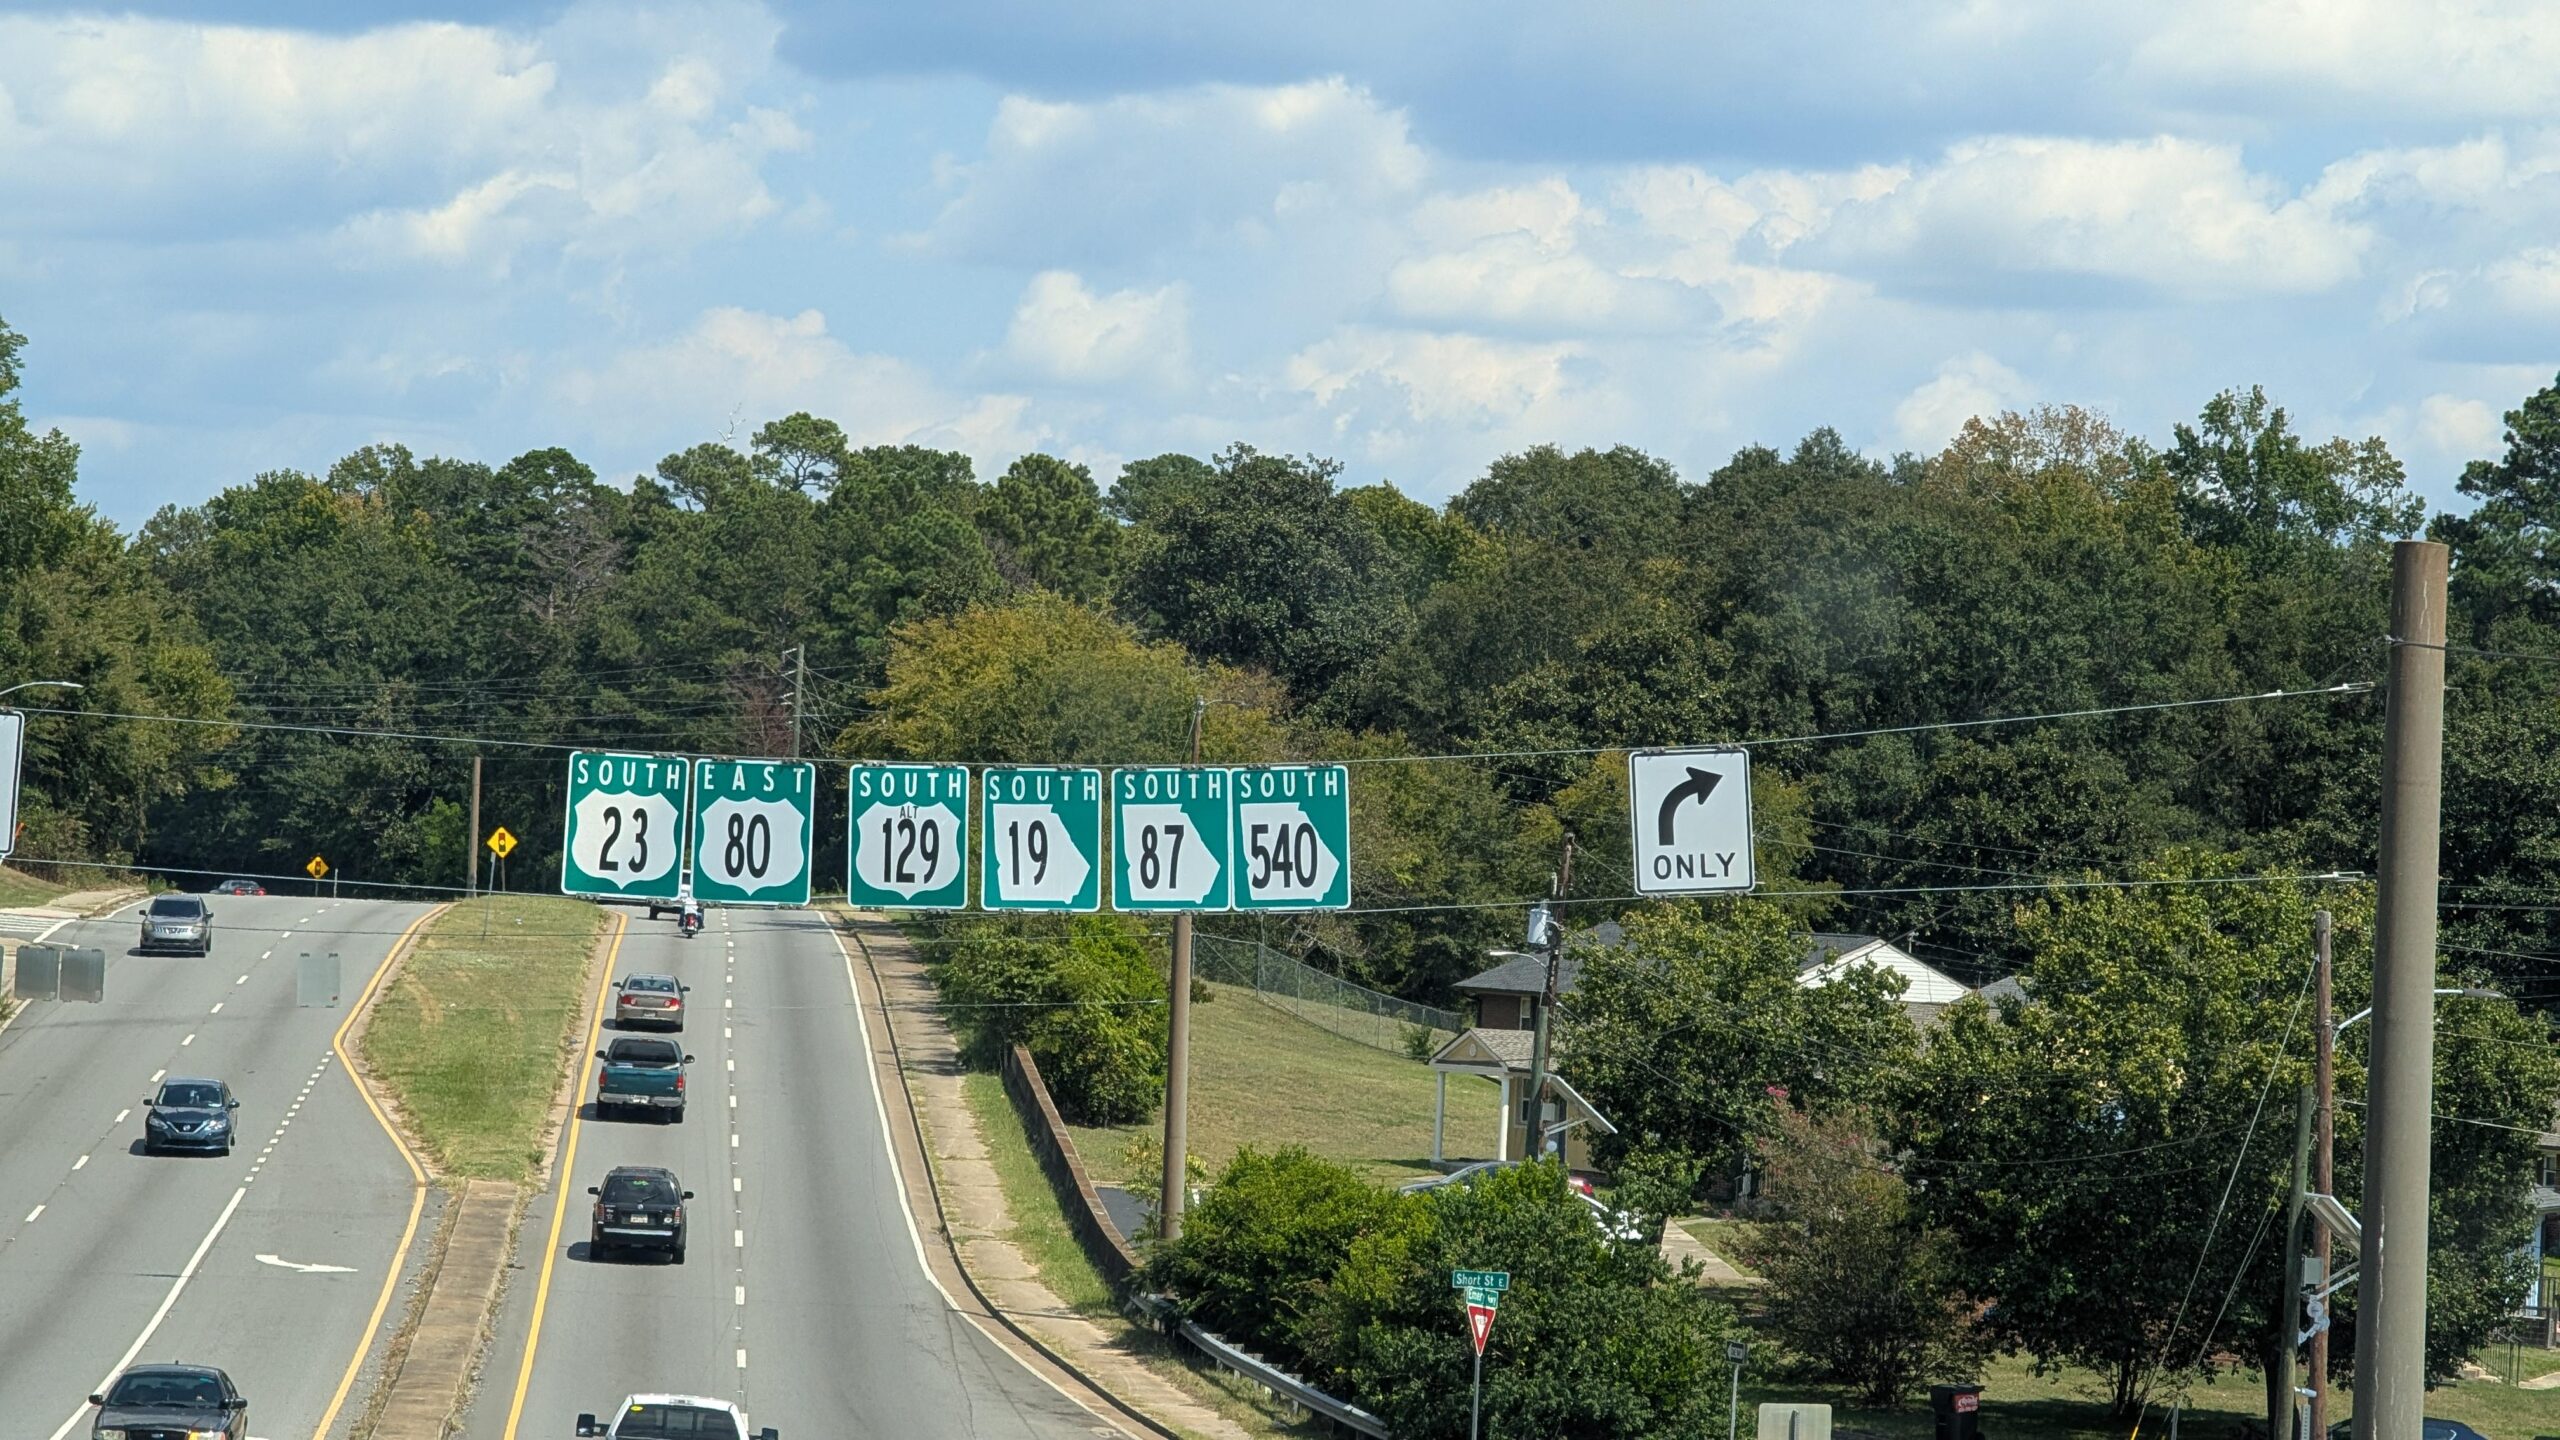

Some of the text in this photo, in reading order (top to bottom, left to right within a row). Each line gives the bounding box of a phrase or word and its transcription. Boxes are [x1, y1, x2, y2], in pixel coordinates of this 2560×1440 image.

[577, 758, 681, 790] SOUTH
[704, 765, 806, 793] EAST
[859, 771, 962, 798] SOUTH
[989, 775, 1097, 801] SOUTH
[1124, 773, 1221, 799] SOUTH
[1240, 770, 1339, 797] SOUTH
[899, 805, 919, 819] ALT
[598, 806, 649, 873] 23
[724, 812, 771, 878] 80
[882, 818, 940, 884] 129
[1009, 820, 1048, 886] 19
[1140, 824, 1185, 890] 87
[1250, 822, 1318, 889] 540
[1653, 852, 1736, 880] ONLY
[1456, 1273, 1480, 1285] Short
[1484, 1275, 1494, 1286] St
